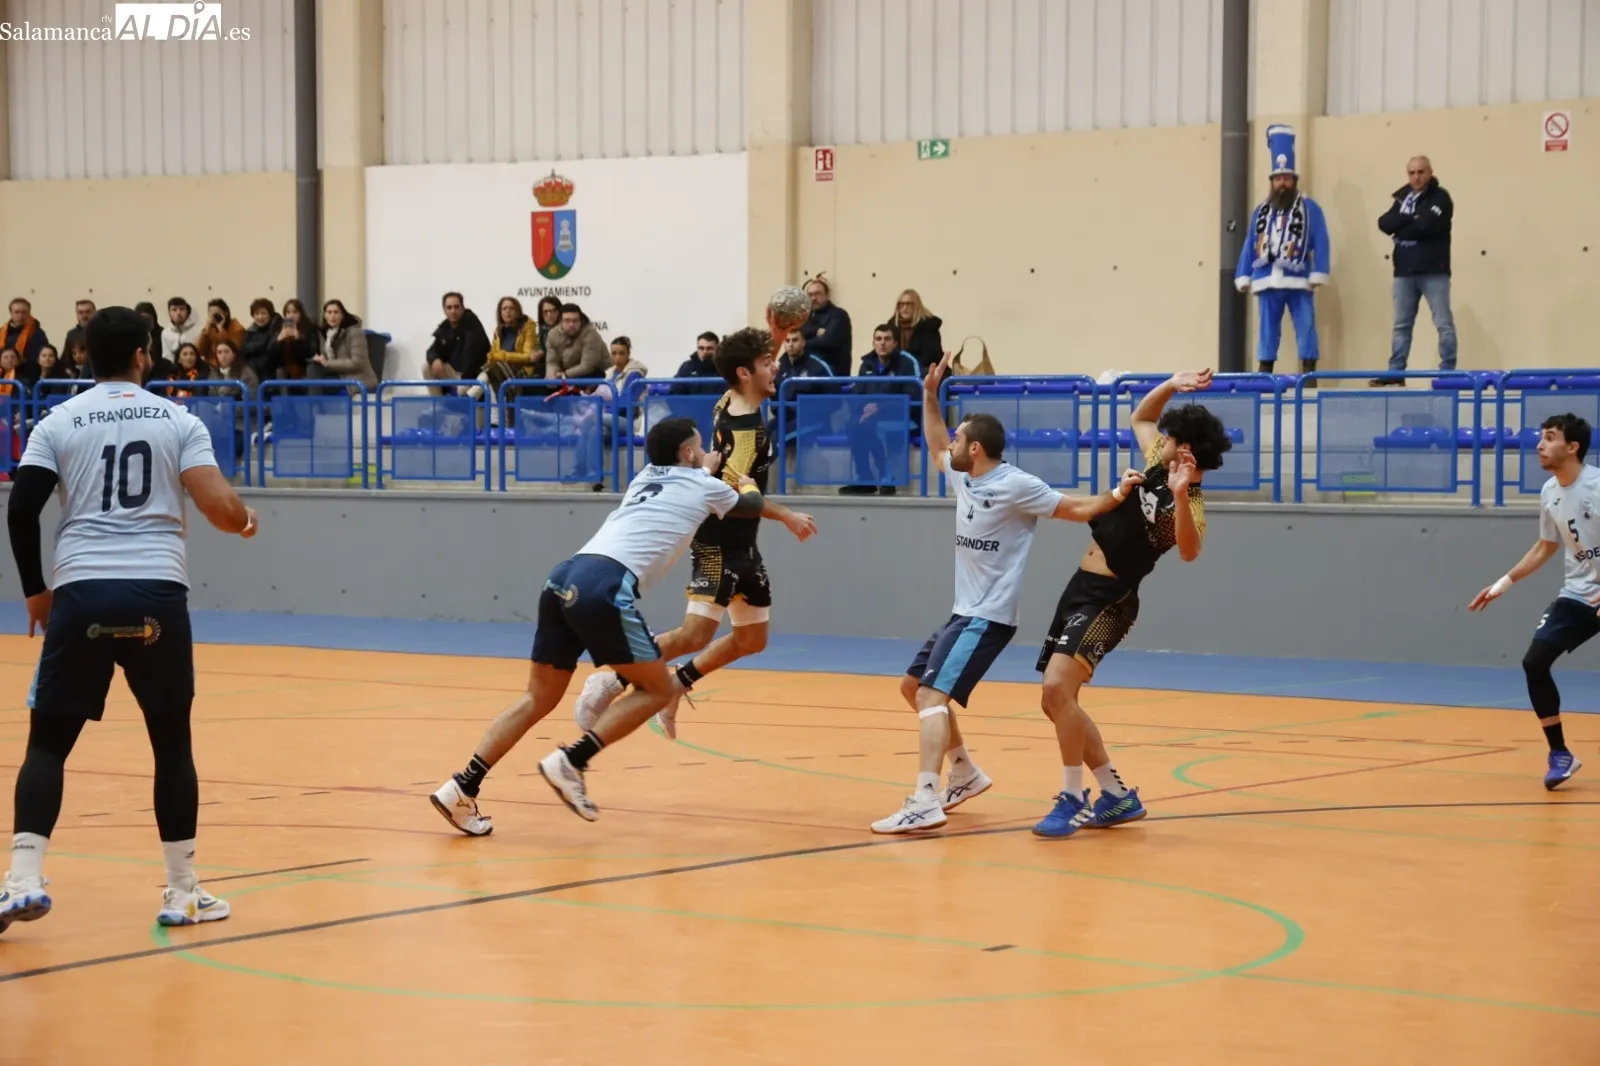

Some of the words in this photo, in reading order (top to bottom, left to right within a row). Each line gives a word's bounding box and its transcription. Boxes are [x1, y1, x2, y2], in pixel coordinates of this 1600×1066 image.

[517, 286, 592, 297] AYUNTAMIENTO
[73, 416, 87, 428] R.
[88, 406, 171, 424] FRANQUEZA
[101, 440, 152, 512] 10
[966, 504, 974, 523] 4
[1567, 519, 1579, 542] 5
